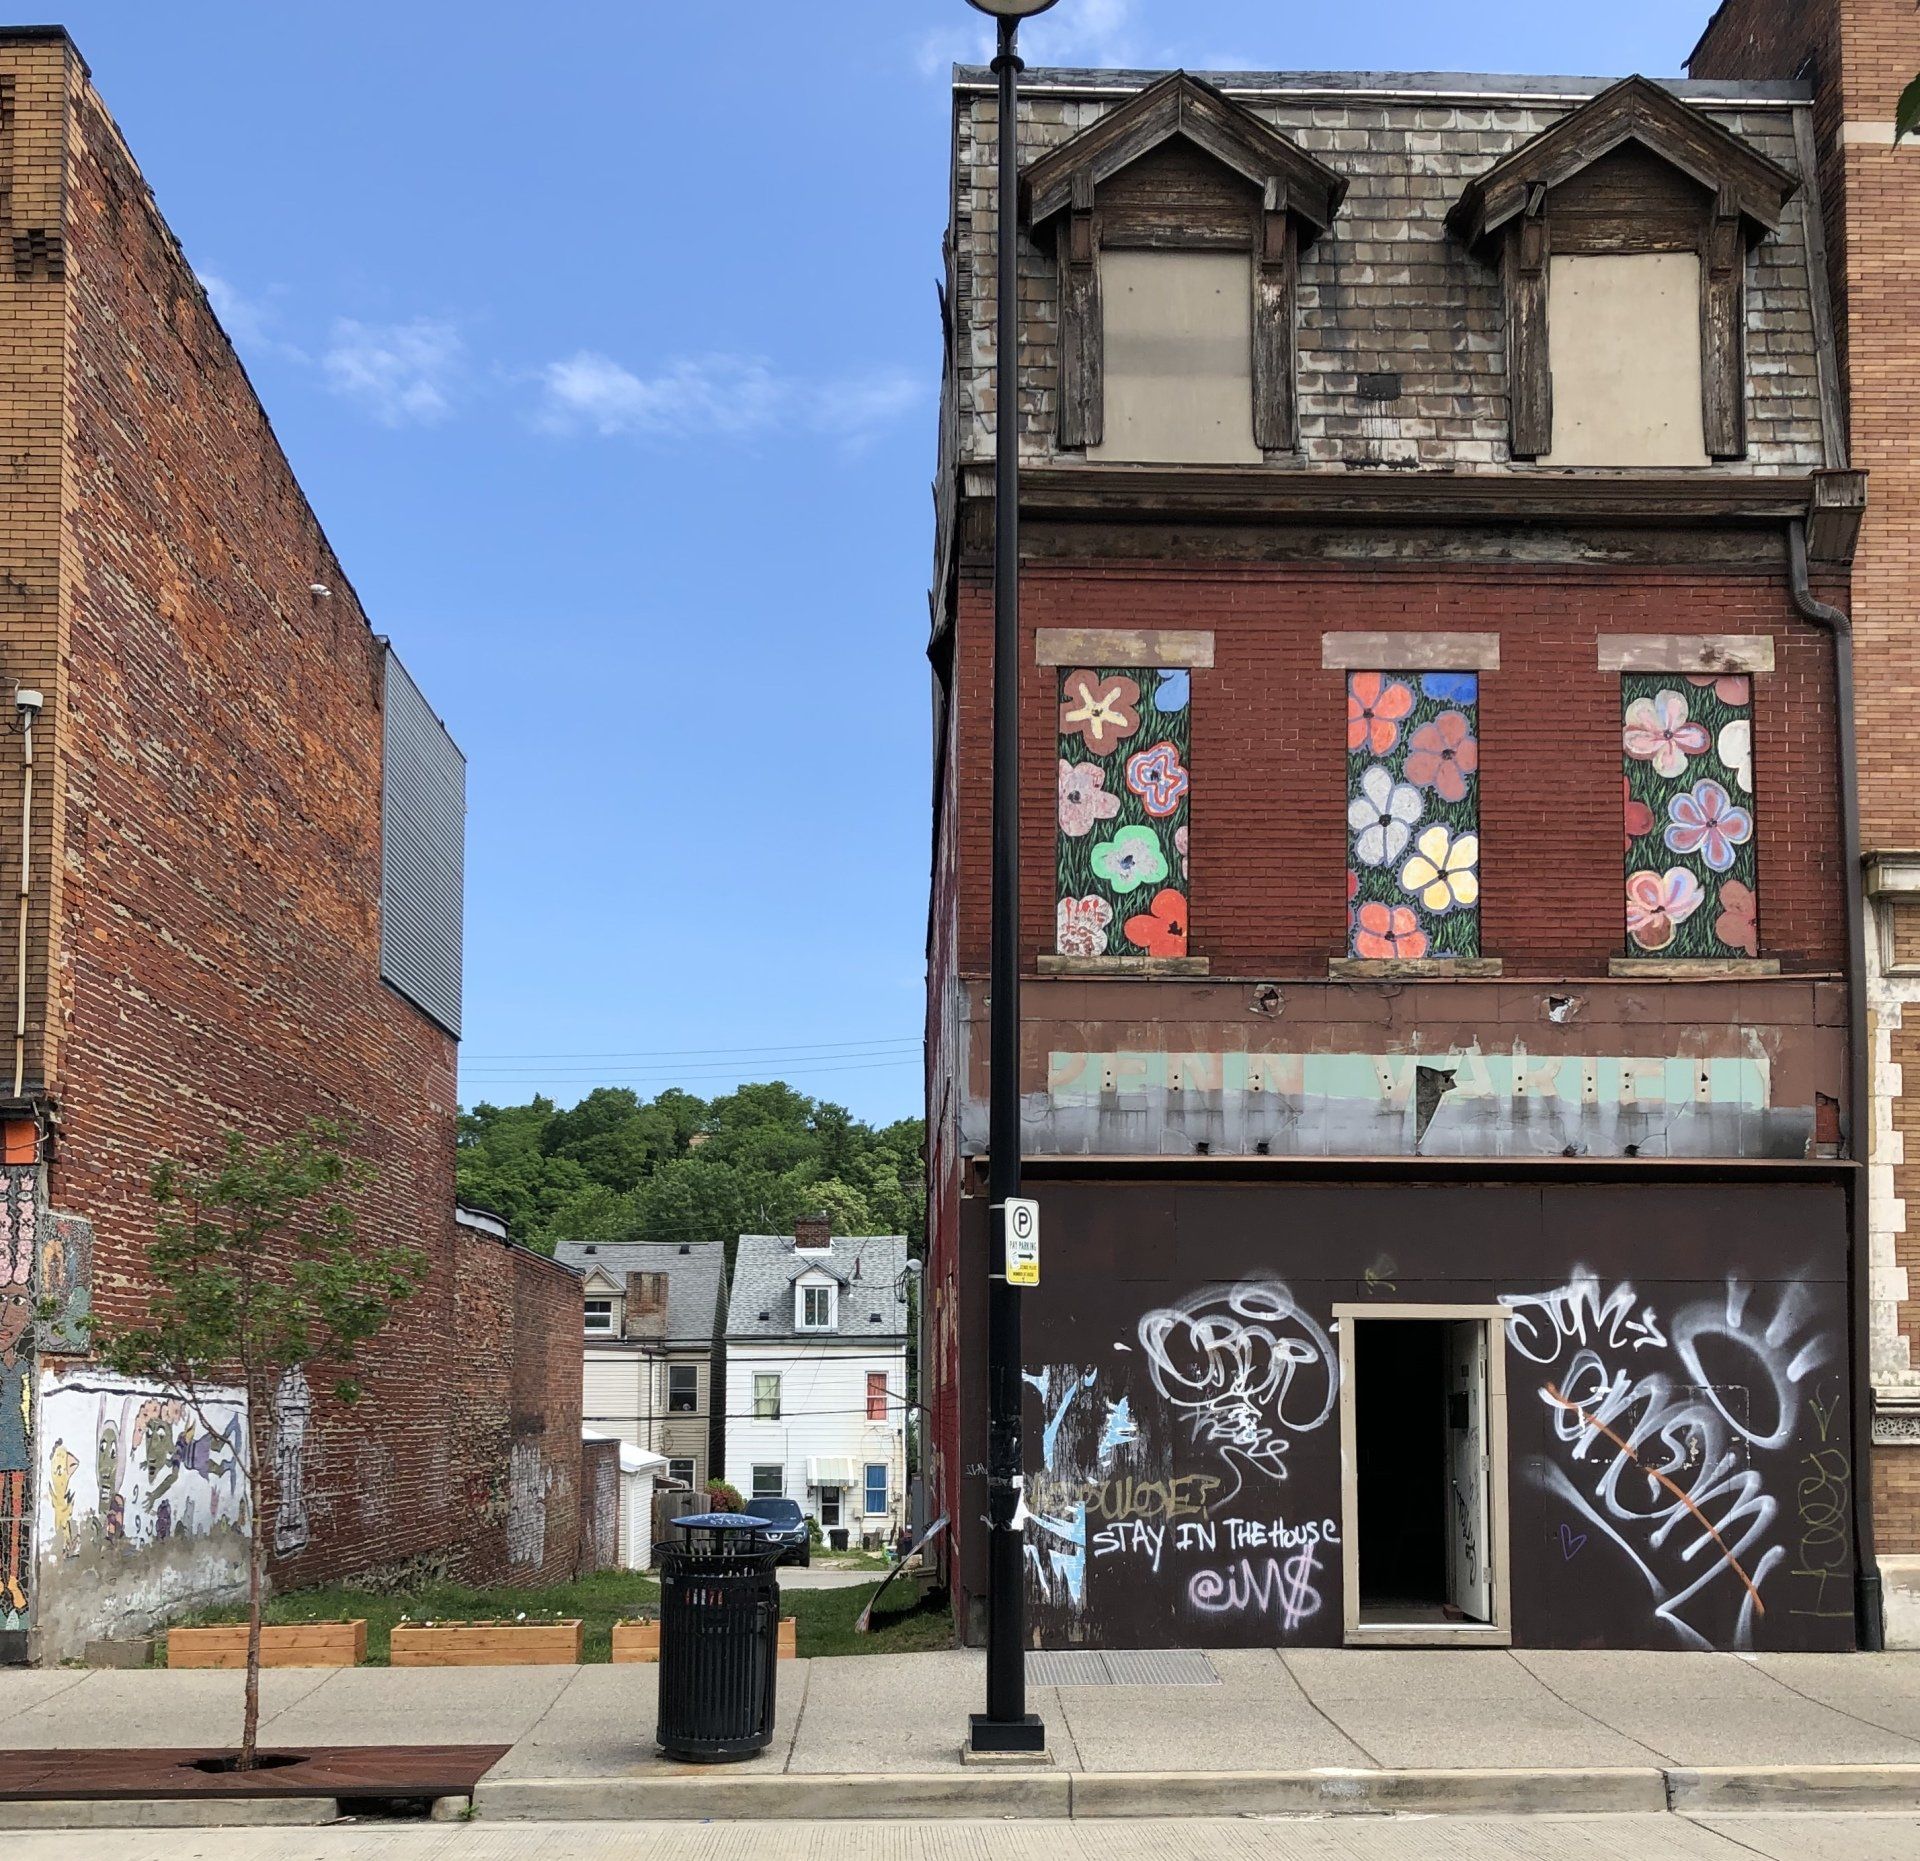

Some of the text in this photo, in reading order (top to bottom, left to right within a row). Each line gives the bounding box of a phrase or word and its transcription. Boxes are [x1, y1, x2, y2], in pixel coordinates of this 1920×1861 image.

[1019, 1241, 1037, 1251] PARKING
[1092, 1519, 1165, 1573] STAY
[1176, 1520, 1216, 1552] IN
[1222, 1517, 1268, 1550] THE
